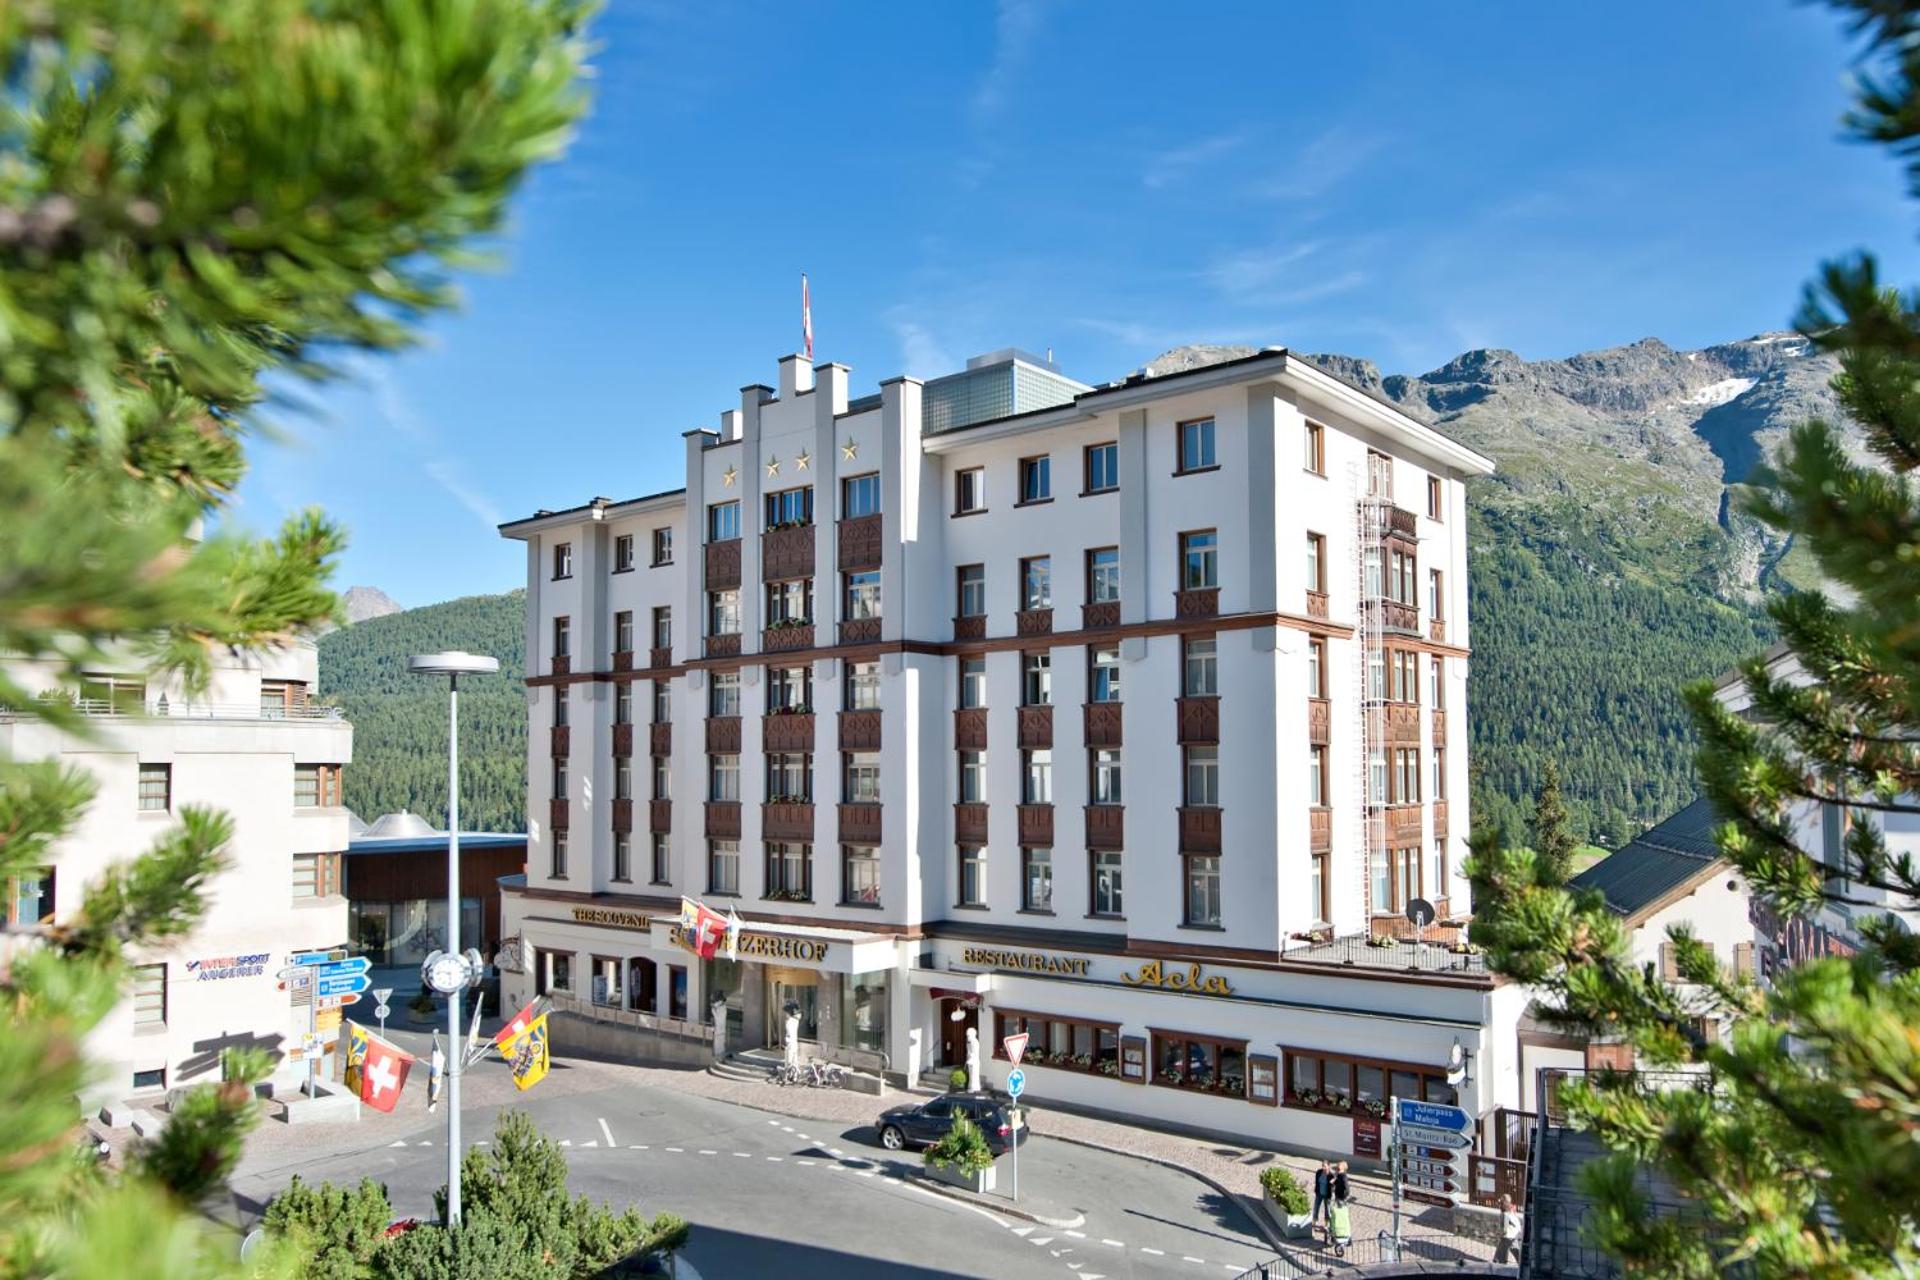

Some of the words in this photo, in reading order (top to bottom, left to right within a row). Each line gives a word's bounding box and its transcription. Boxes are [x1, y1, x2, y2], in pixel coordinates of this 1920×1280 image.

[669, 925, 829, 962] SZERHOF
[197, 965, 263, 981] ANGERER
[200, 953, 270, 970] INTERSPORT
[963, 946, 1090, 977] RESTAURANT
[1120, 959, 1236, 995] Acla
